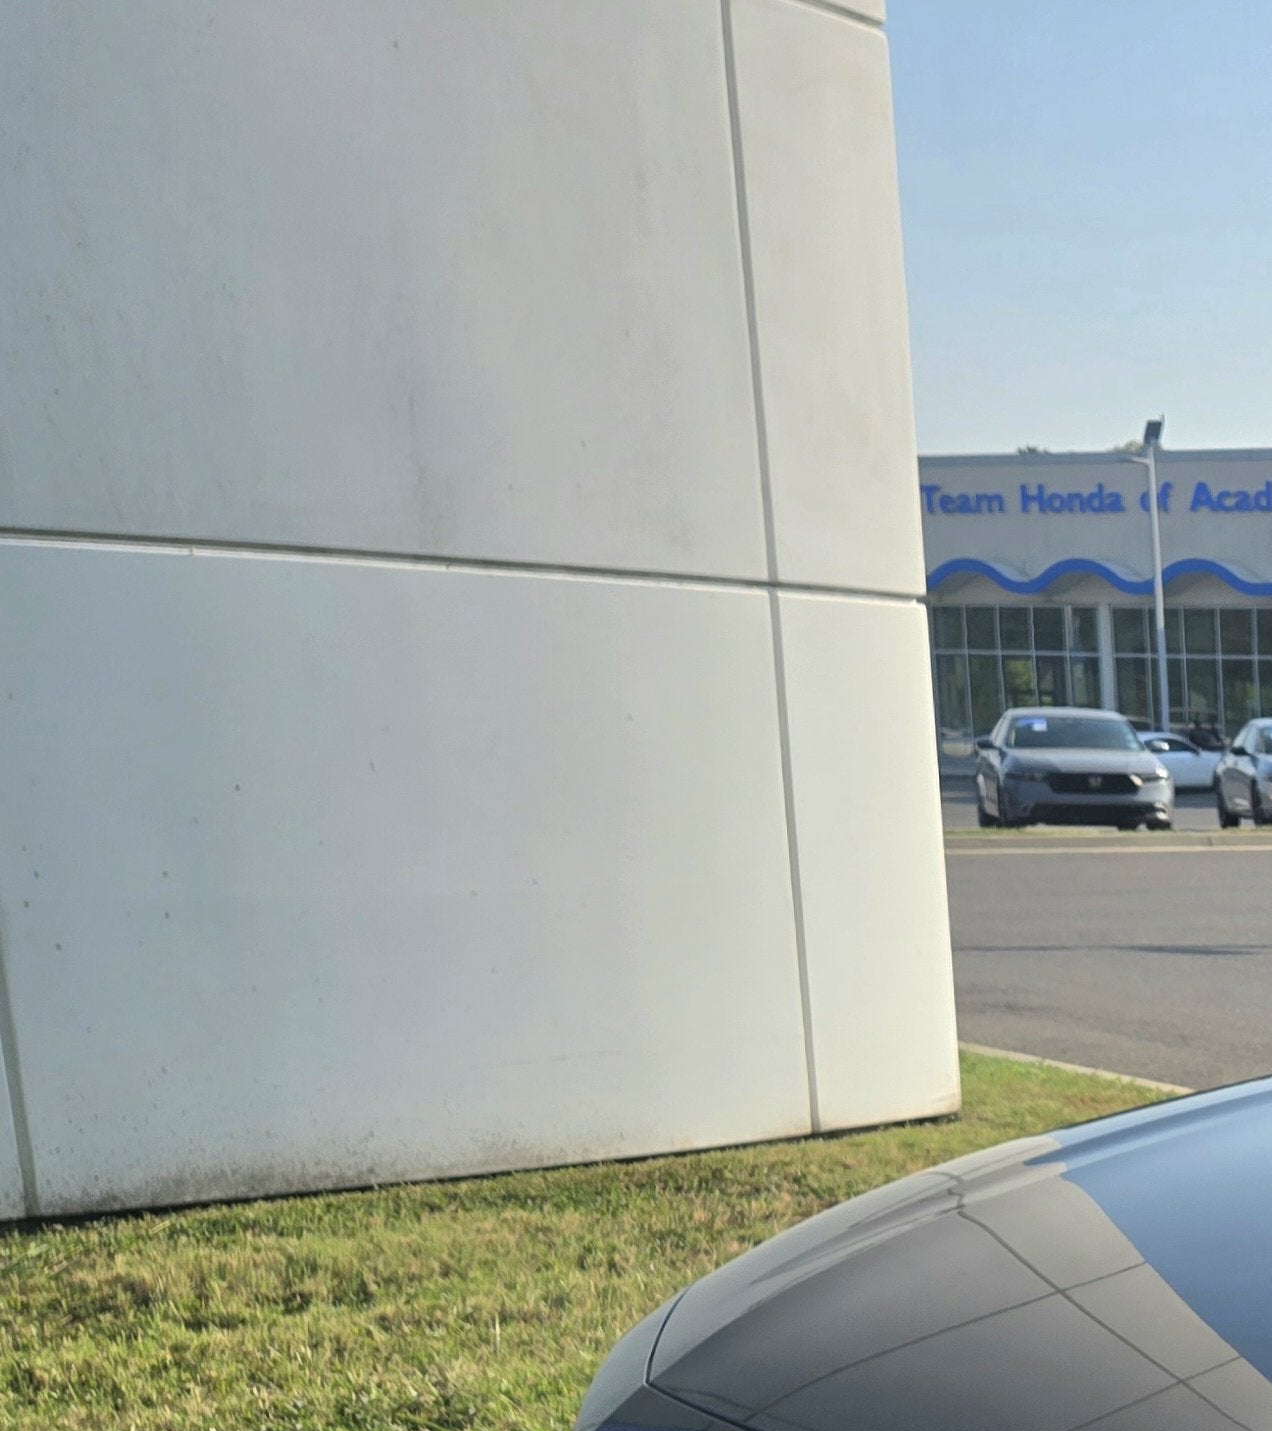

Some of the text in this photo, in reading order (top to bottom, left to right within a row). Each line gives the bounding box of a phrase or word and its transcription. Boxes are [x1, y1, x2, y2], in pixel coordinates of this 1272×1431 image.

[920, 484, 1004, 514] Team
[1019, 483, 1126, 514] Honda
[1140, 481, 1173, 514] of
